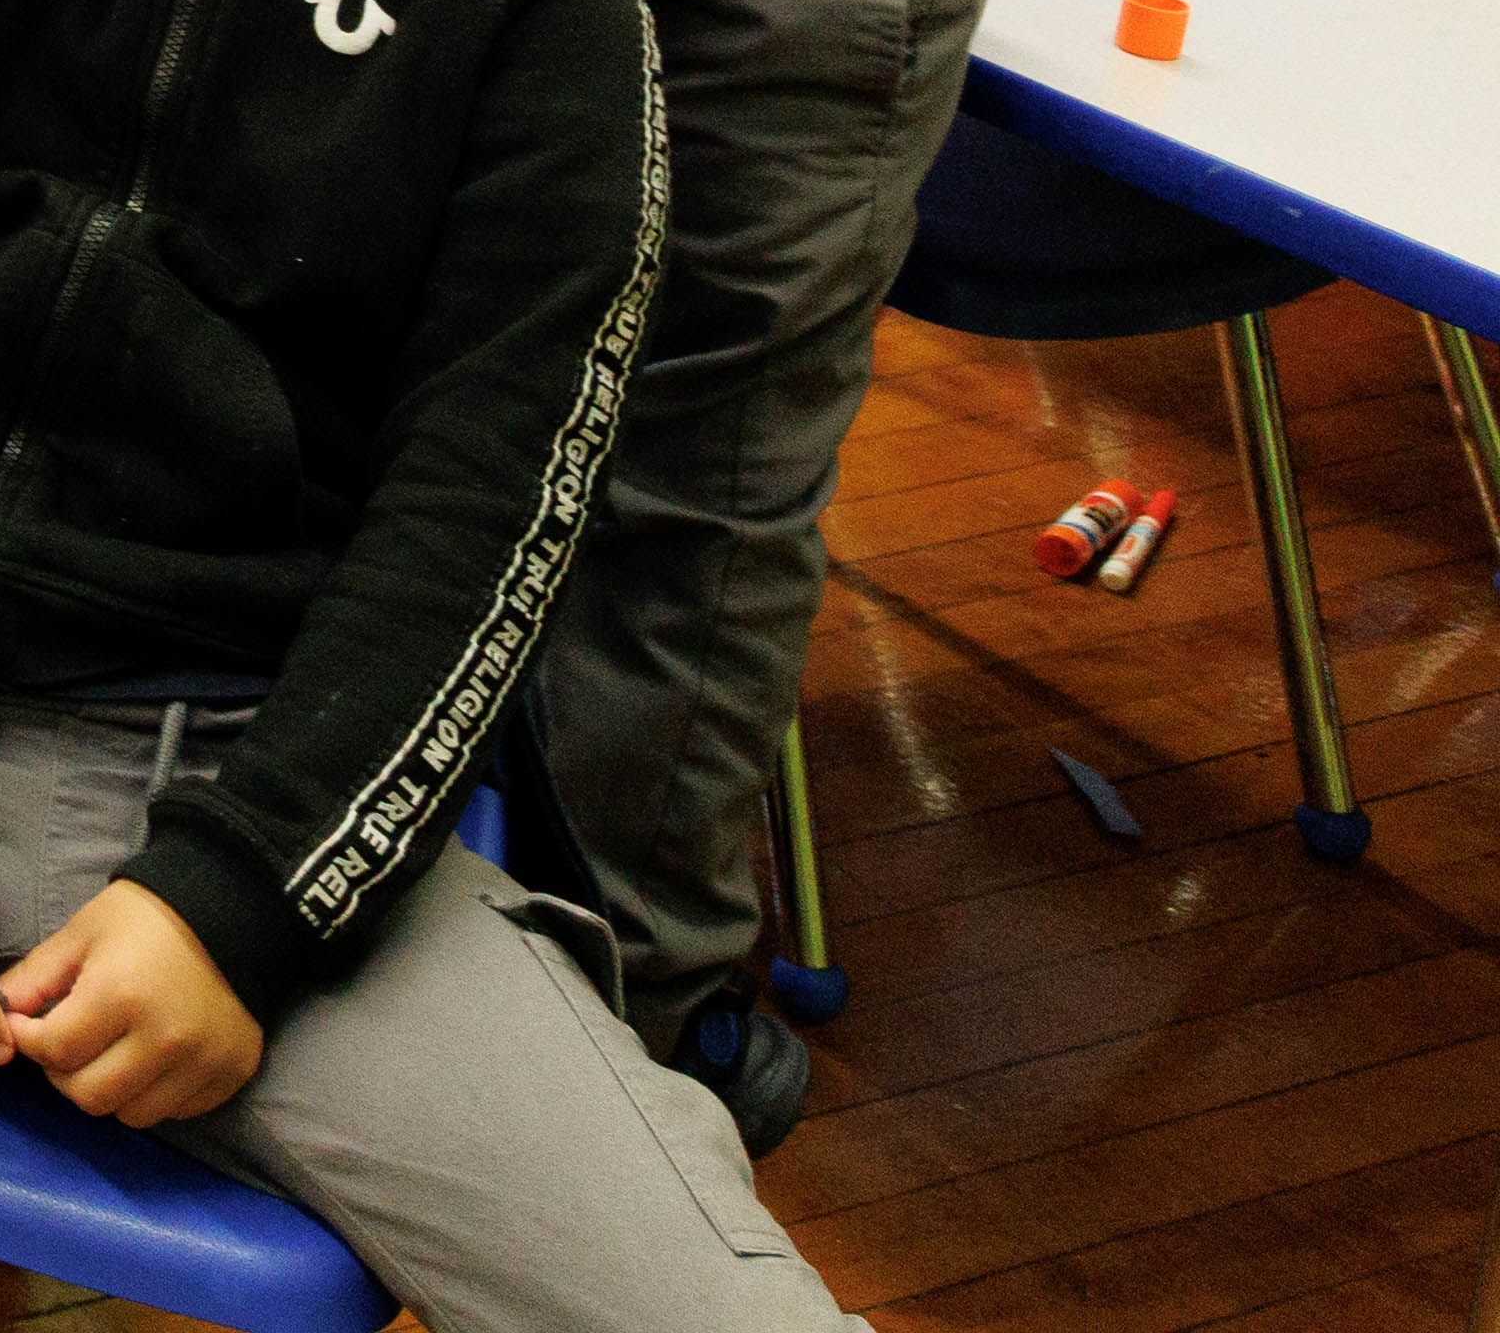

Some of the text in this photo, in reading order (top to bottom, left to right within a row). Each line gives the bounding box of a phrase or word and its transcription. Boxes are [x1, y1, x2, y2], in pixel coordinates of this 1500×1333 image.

[554, 361, 617, 526] RELIGION
[420, 618, 525, 774] RELIGION
[359, 776, 430, 856] TRUE
